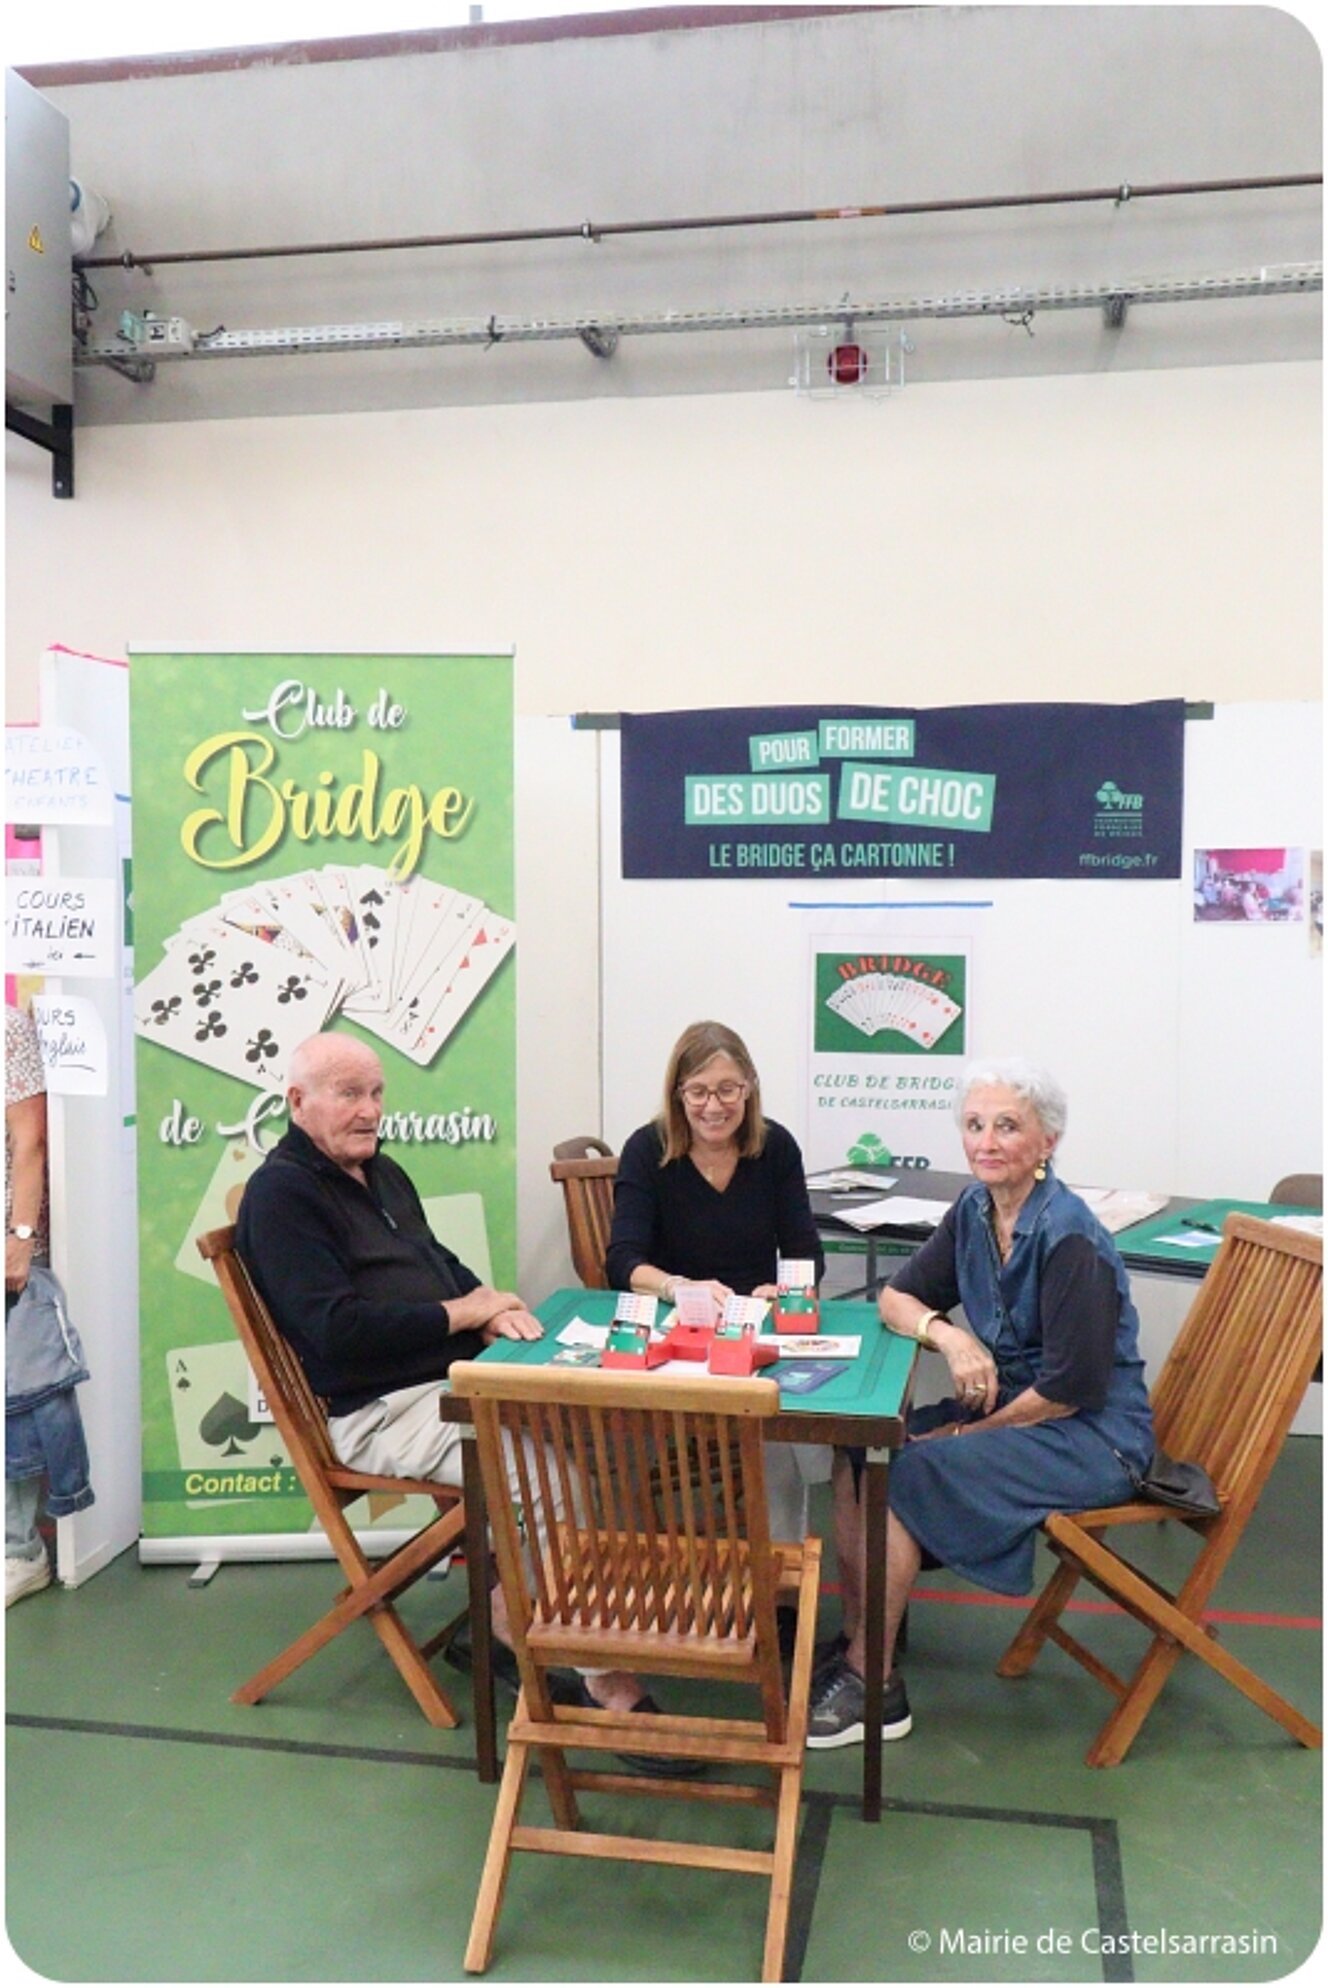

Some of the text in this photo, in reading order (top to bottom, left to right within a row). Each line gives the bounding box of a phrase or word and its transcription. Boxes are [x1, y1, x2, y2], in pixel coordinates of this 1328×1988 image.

[241, 679, 408, 739] Club de
[758, 726, 910, 765] POUR FORMER
[180, 731, 474, 883] Bridge
[693, 771, 985, 821] DES DUOS DE CHOC
[709, 843, 955, 872] LE BRIDGE ÇA CARTONNE !
[1078, 852, 1159, 870] ffbridge.fr
[17, 890, 85, 911] COURS
[837, 954, 953, 989] BRIDGE
[38, 1029, 87, 1068] nglais
[813, 1073, 959, 1090] CLUB DE BRIDG
[817, 1096, 952, 1110] DE CASTELSARRASI
[160, 1098, 204, 1146] de
[185, 1472, 295, 1496] Contact :
